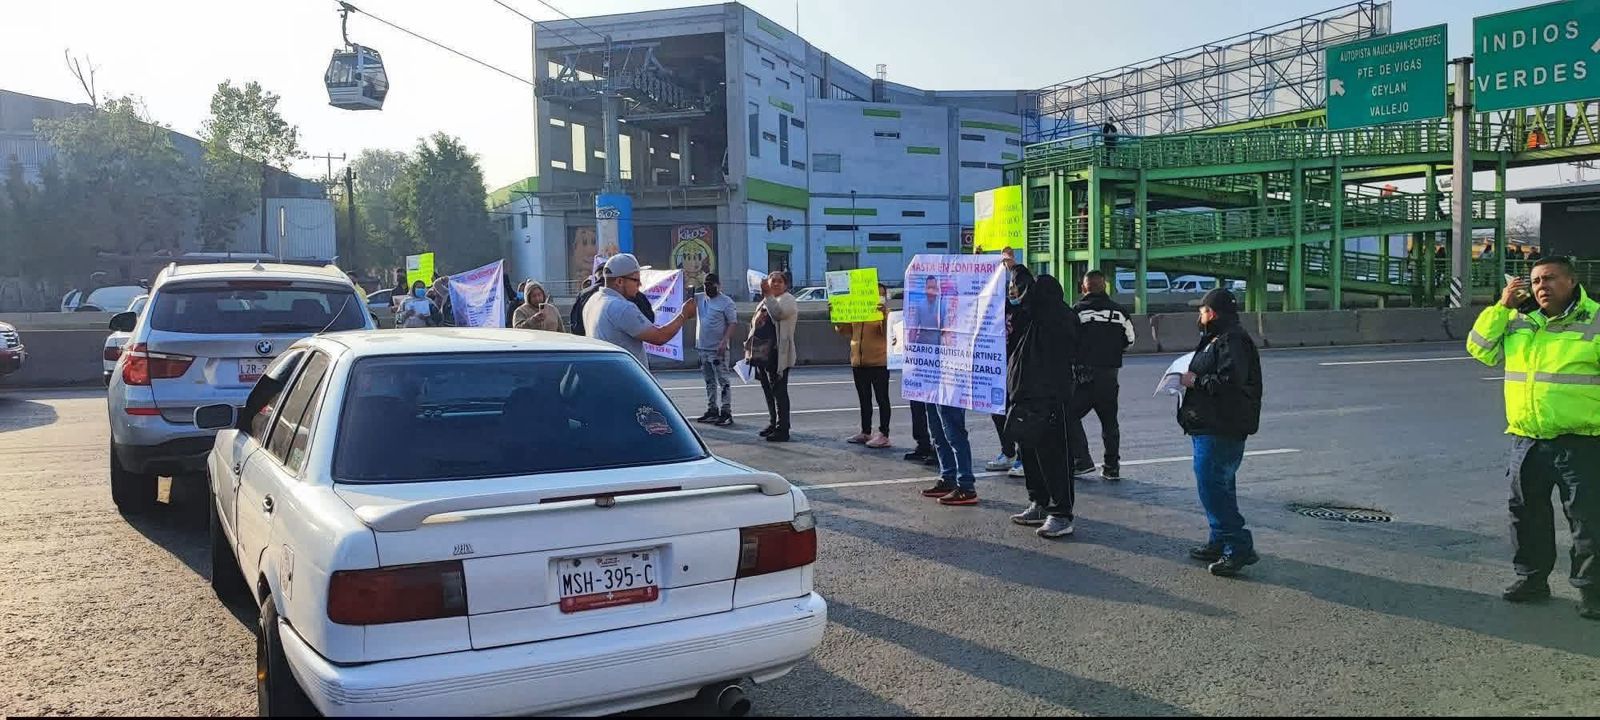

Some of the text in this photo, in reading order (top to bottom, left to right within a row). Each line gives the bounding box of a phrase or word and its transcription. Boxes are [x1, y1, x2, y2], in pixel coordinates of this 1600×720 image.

[1340, 34, 1441, 62] AUTOPISTA NAUCALPAN-ECATEPEC
[1482, 20, 1580, 53] INDIOS
[1380, 63, 1391, 75] DE
[1395, 59, 1422, 73] VIGAS
[1477, 60, 1588, 93] VERDES
[1371, 81, 1407, 96] CEYLAN
[1370, 102, 1409, 116] VALLEJO
[904, 344, 1002, 362] NAZARIO BAUTISTA MARTINEZ
[562, 564, 654, 595] MSH-395-C
